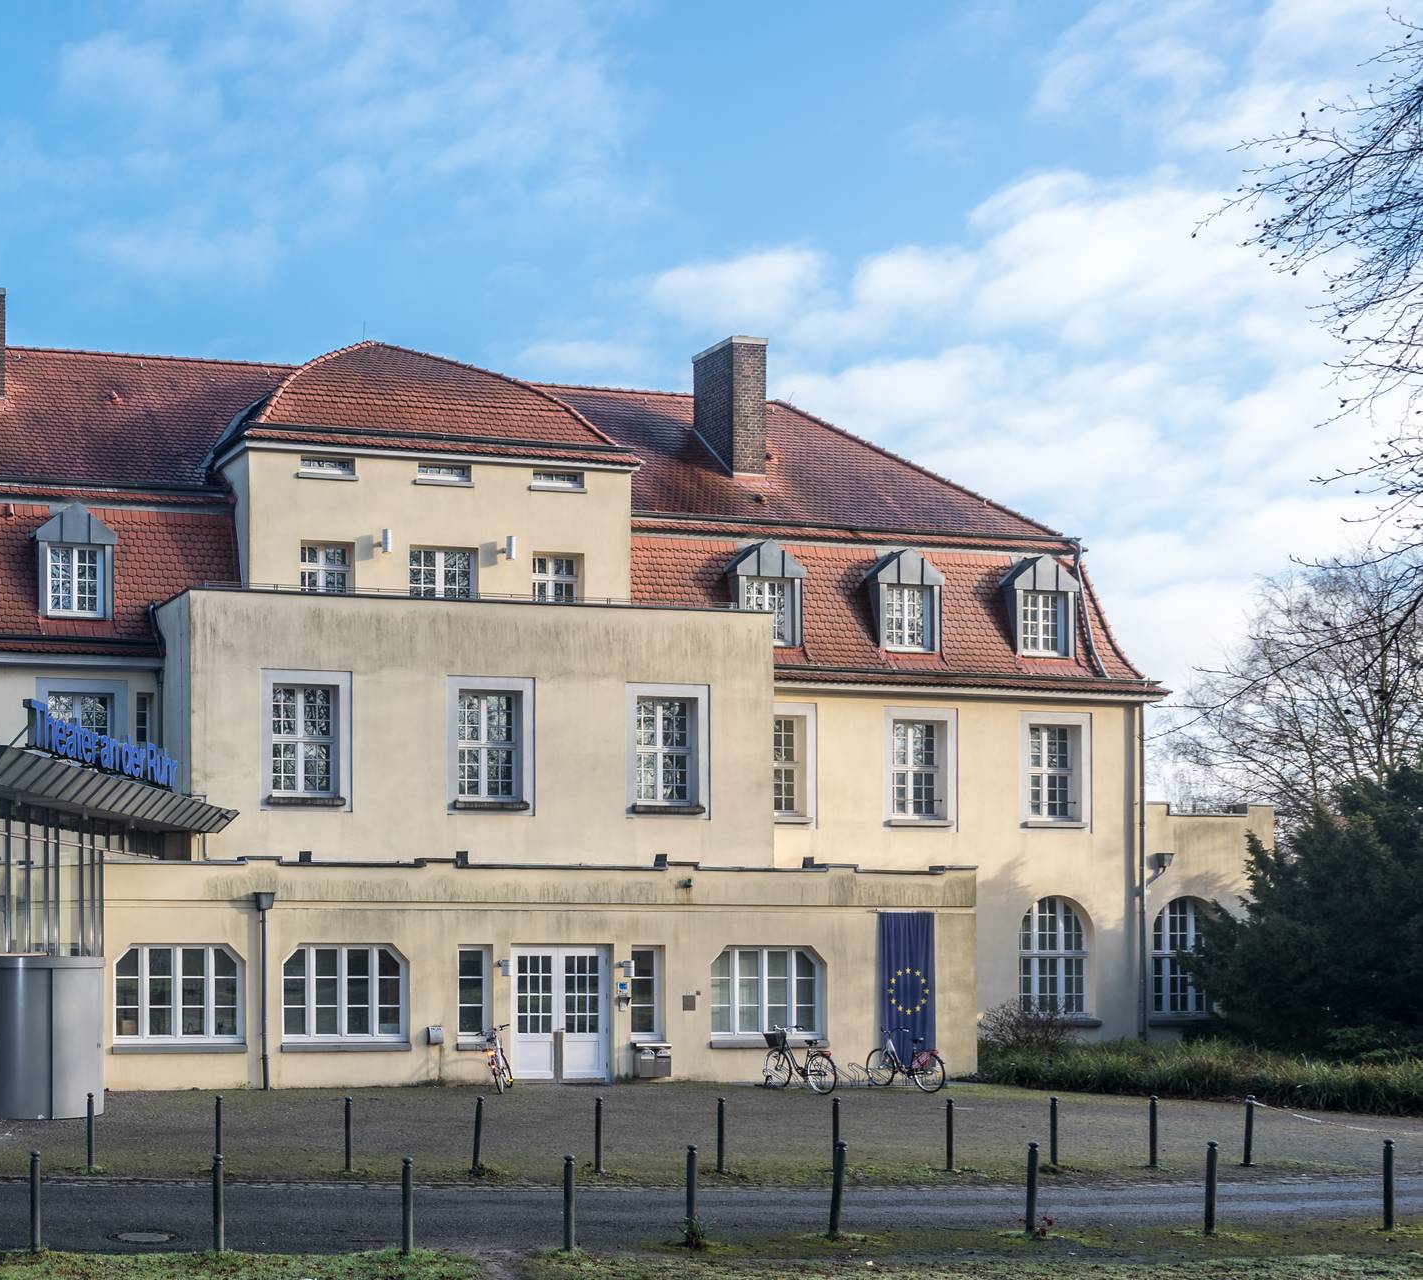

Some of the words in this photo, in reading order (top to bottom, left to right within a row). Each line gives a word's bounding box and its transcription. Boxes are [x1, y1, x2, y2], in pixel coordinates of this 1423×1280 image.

[29, 699, 98, 763] Theater
[100, 735, 119, 770] an
[122, 735, 146, 778] der
[147, 741, 178, 787] Ruhr
